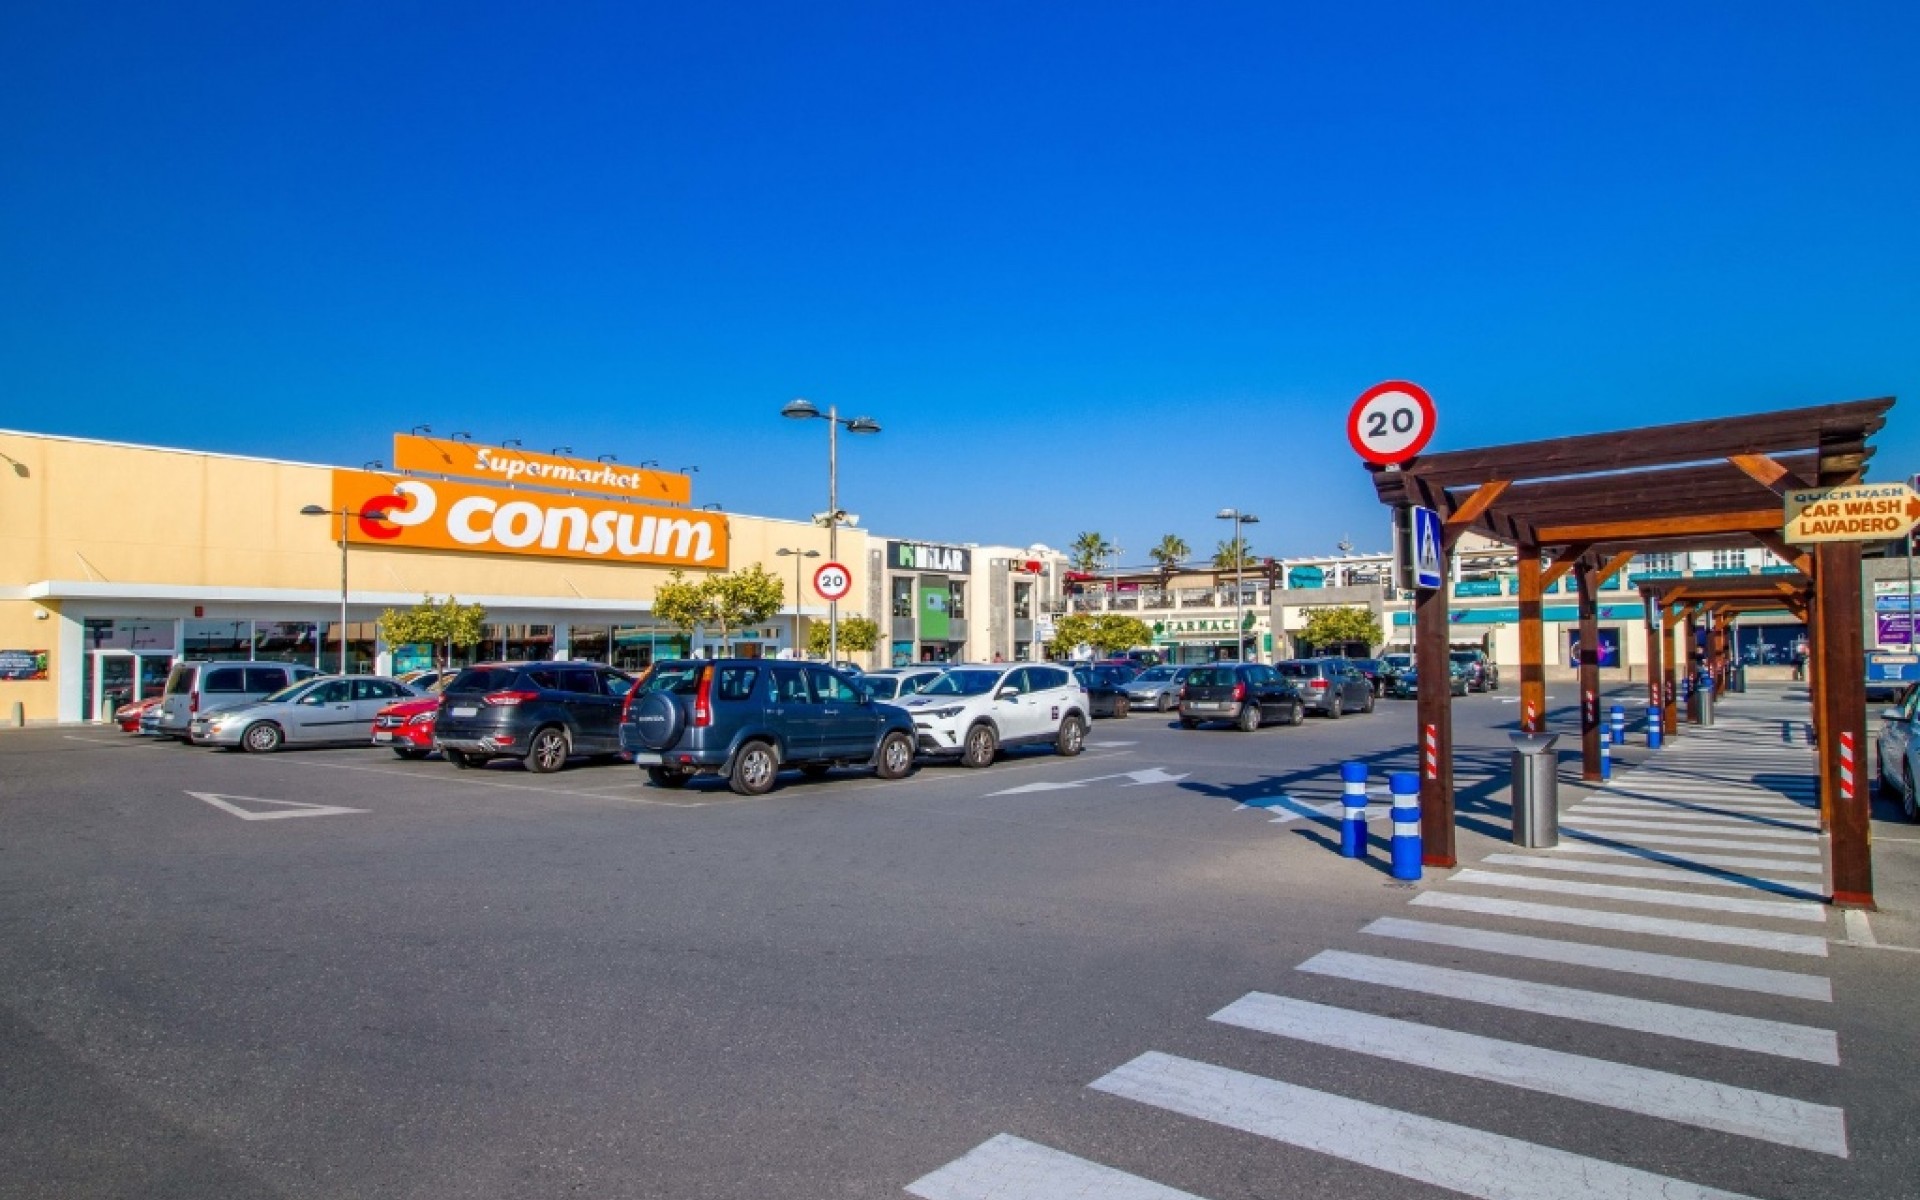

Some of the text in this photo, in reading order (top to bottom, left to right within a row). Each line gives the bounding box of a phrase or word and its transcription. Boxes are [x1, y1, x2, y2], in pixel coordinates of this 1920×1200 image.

[1366, 407, 1415, 438] 20
[474, 448, 641, 489] Supermarket
[1856, 487, 1903, 498] WASH
[1801, 499, 1902, 518] CAR WASH
[447, 495, 716, 562] consum
[1801, 516, 1901, 536] LAVADERO
[822, 574, 843, 588] 20
[1166, 619, 1239, 632] FARMACI
